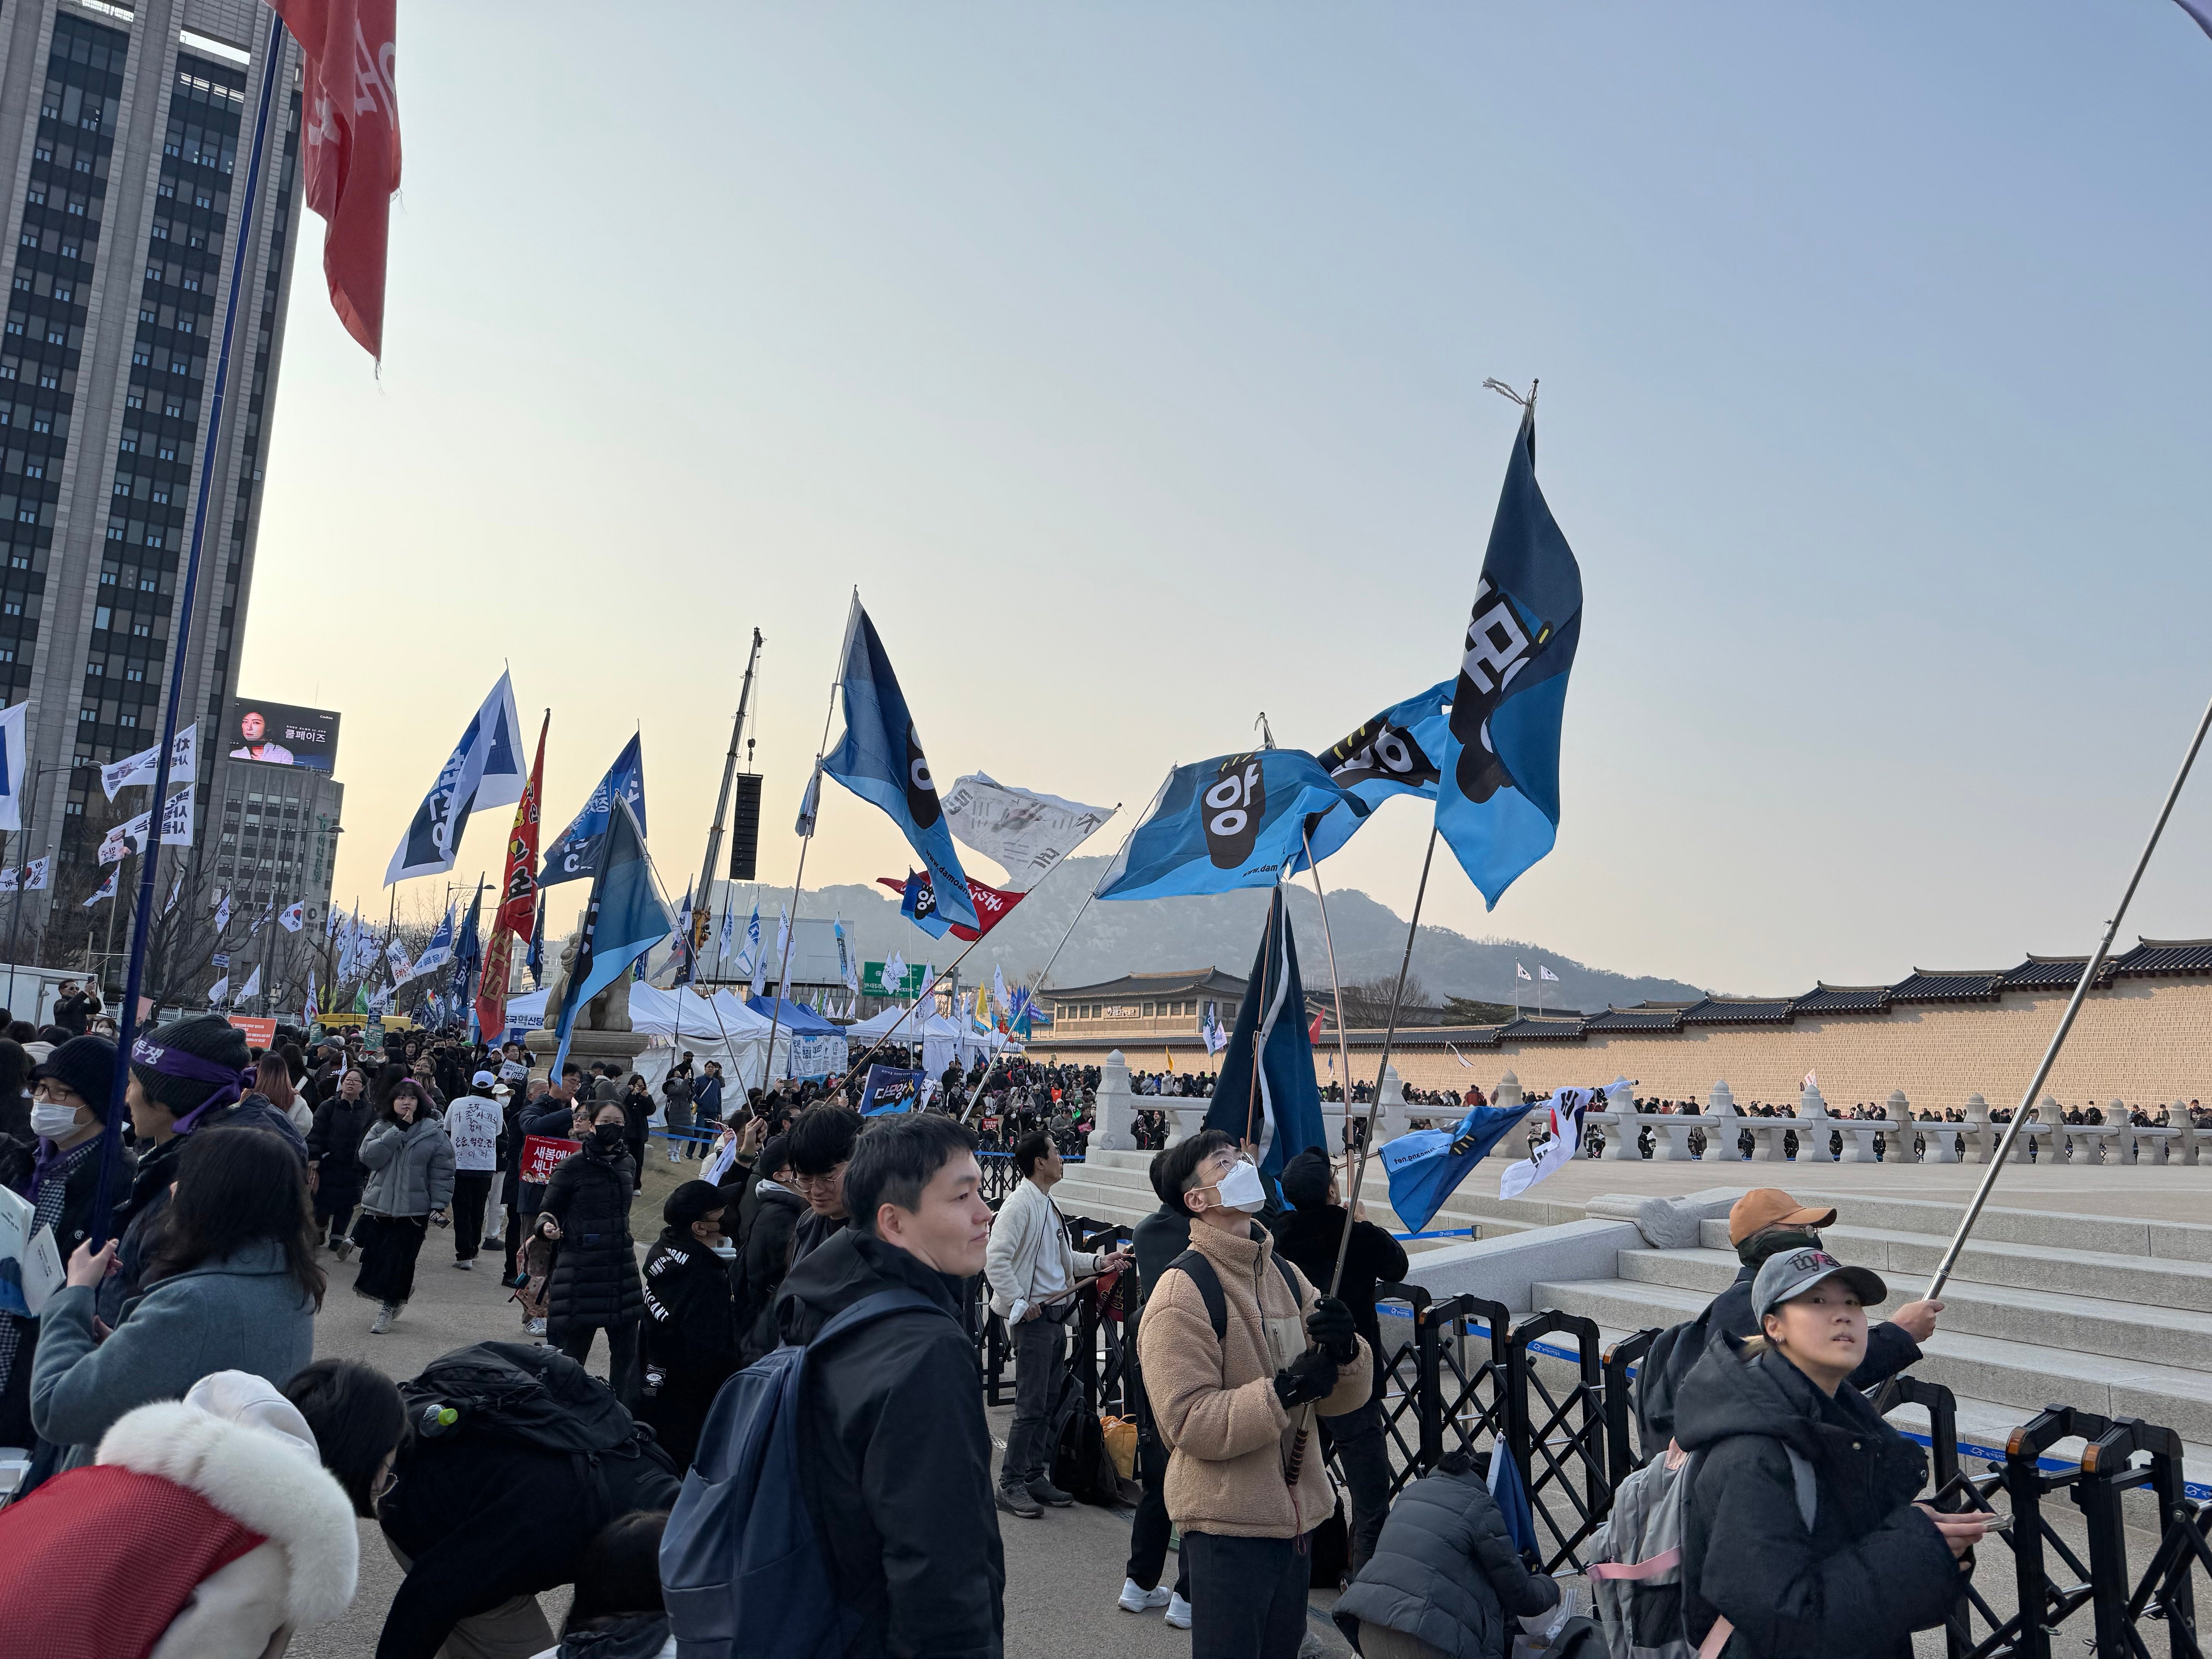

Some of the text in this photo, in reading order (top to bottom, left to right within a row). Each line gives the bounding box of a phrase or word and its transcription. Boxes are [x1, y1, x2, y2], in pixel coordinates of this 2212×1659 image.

[505, 1015, 544, 1026] 조국혁신당
[135, 1040, 165, 1064] 투쟁
[874, 1082, 907, 1099] 다모앙
